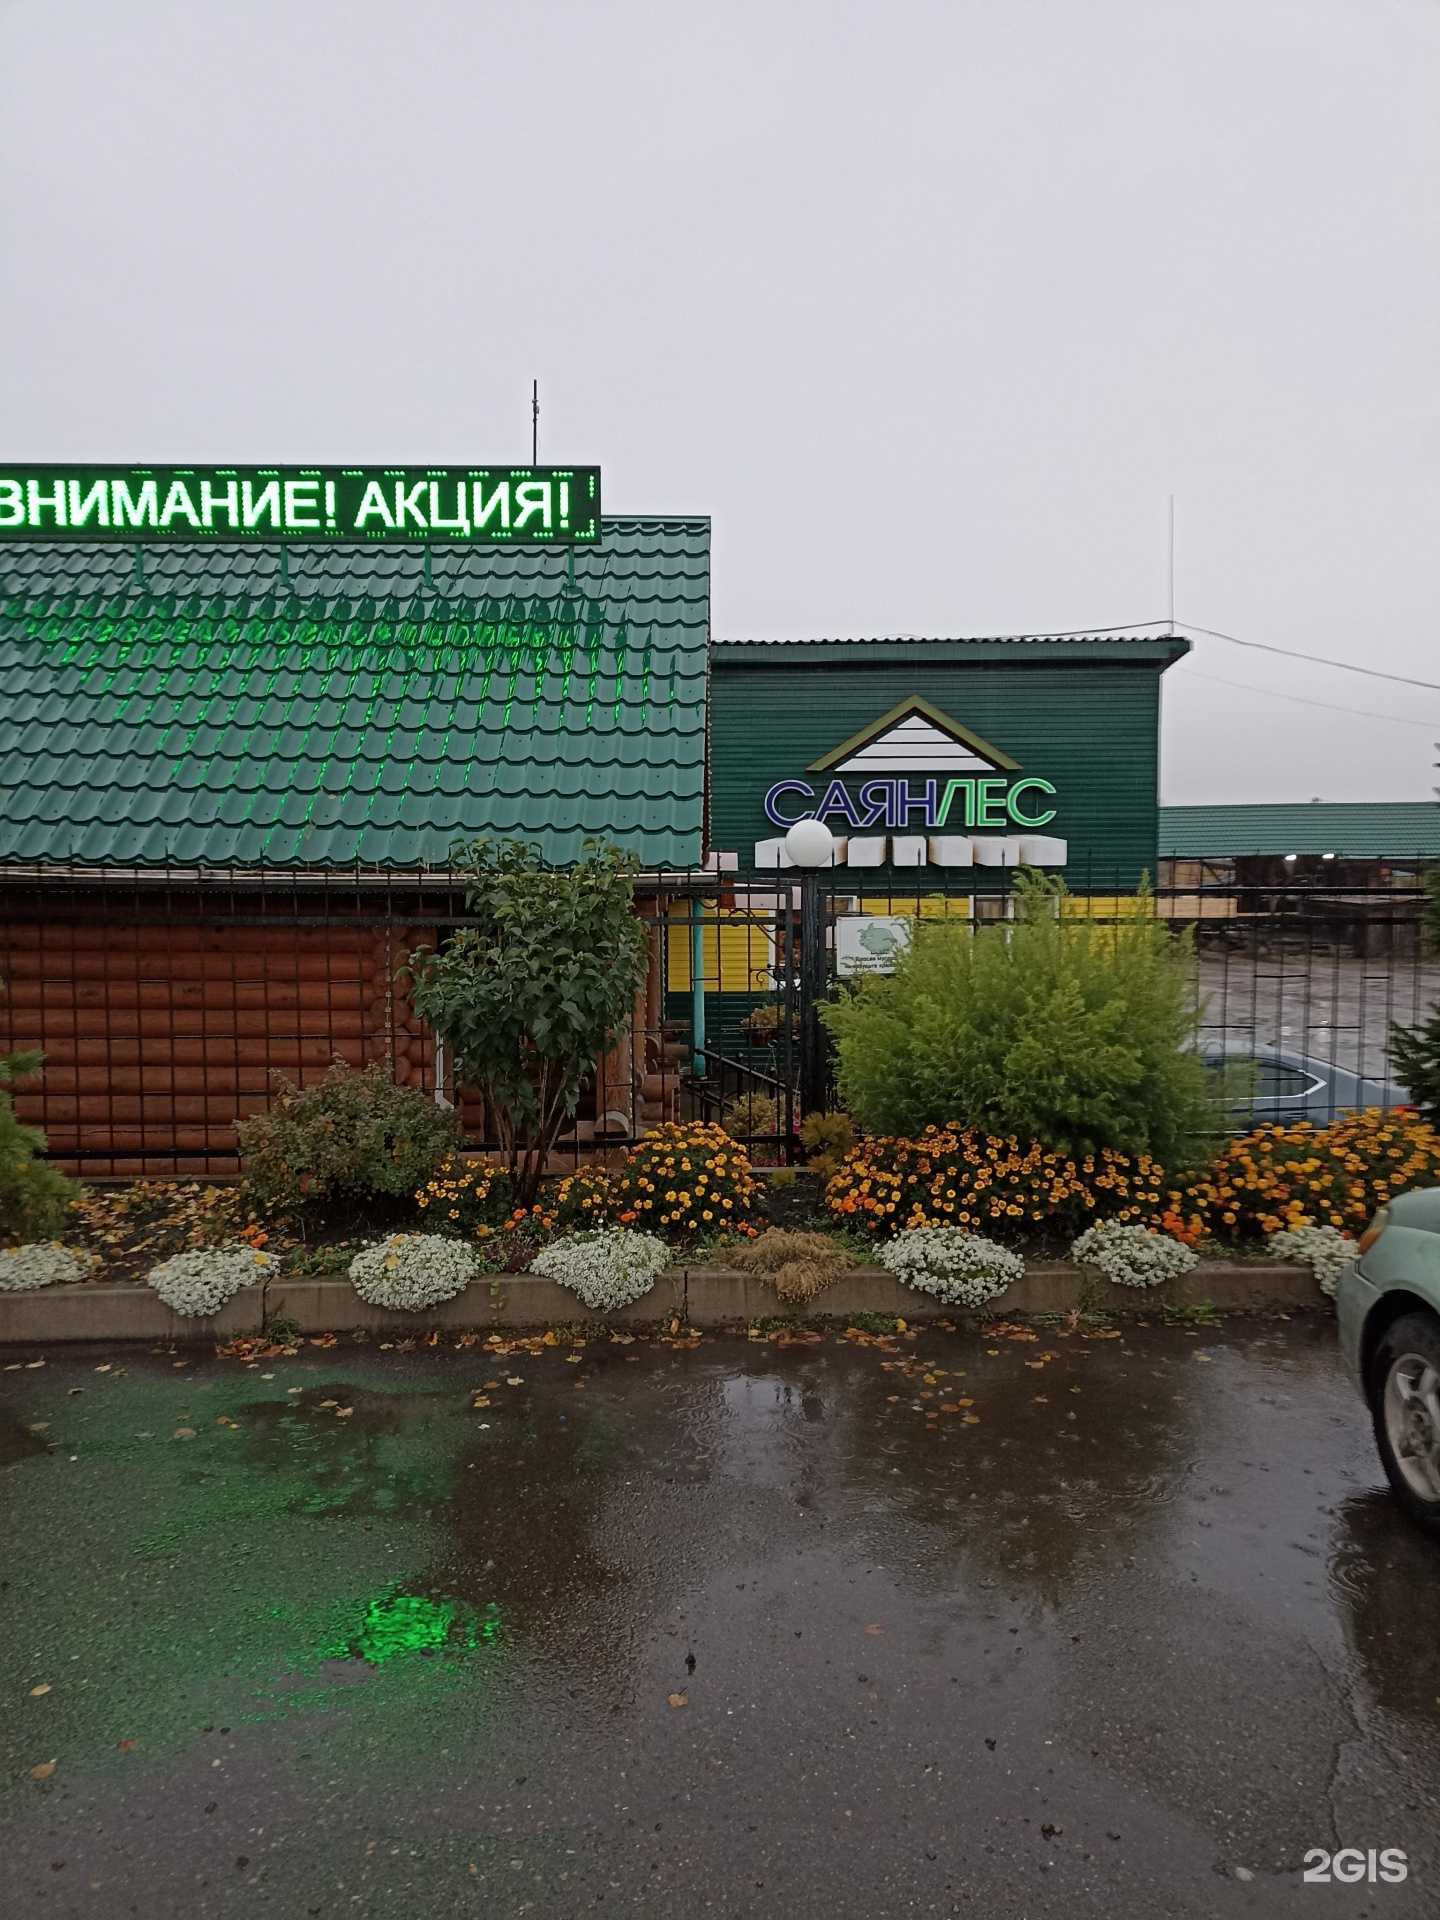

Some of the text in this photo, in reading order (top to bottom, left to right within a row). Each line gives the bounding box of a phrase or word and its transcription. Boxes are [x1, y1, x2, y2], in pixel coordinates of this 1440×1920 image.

[0, 479, 569, 537] ВНИМАНИЕ! АКЦИЯ!
[764, 778, 1056, 827] САЯНЛЕС
